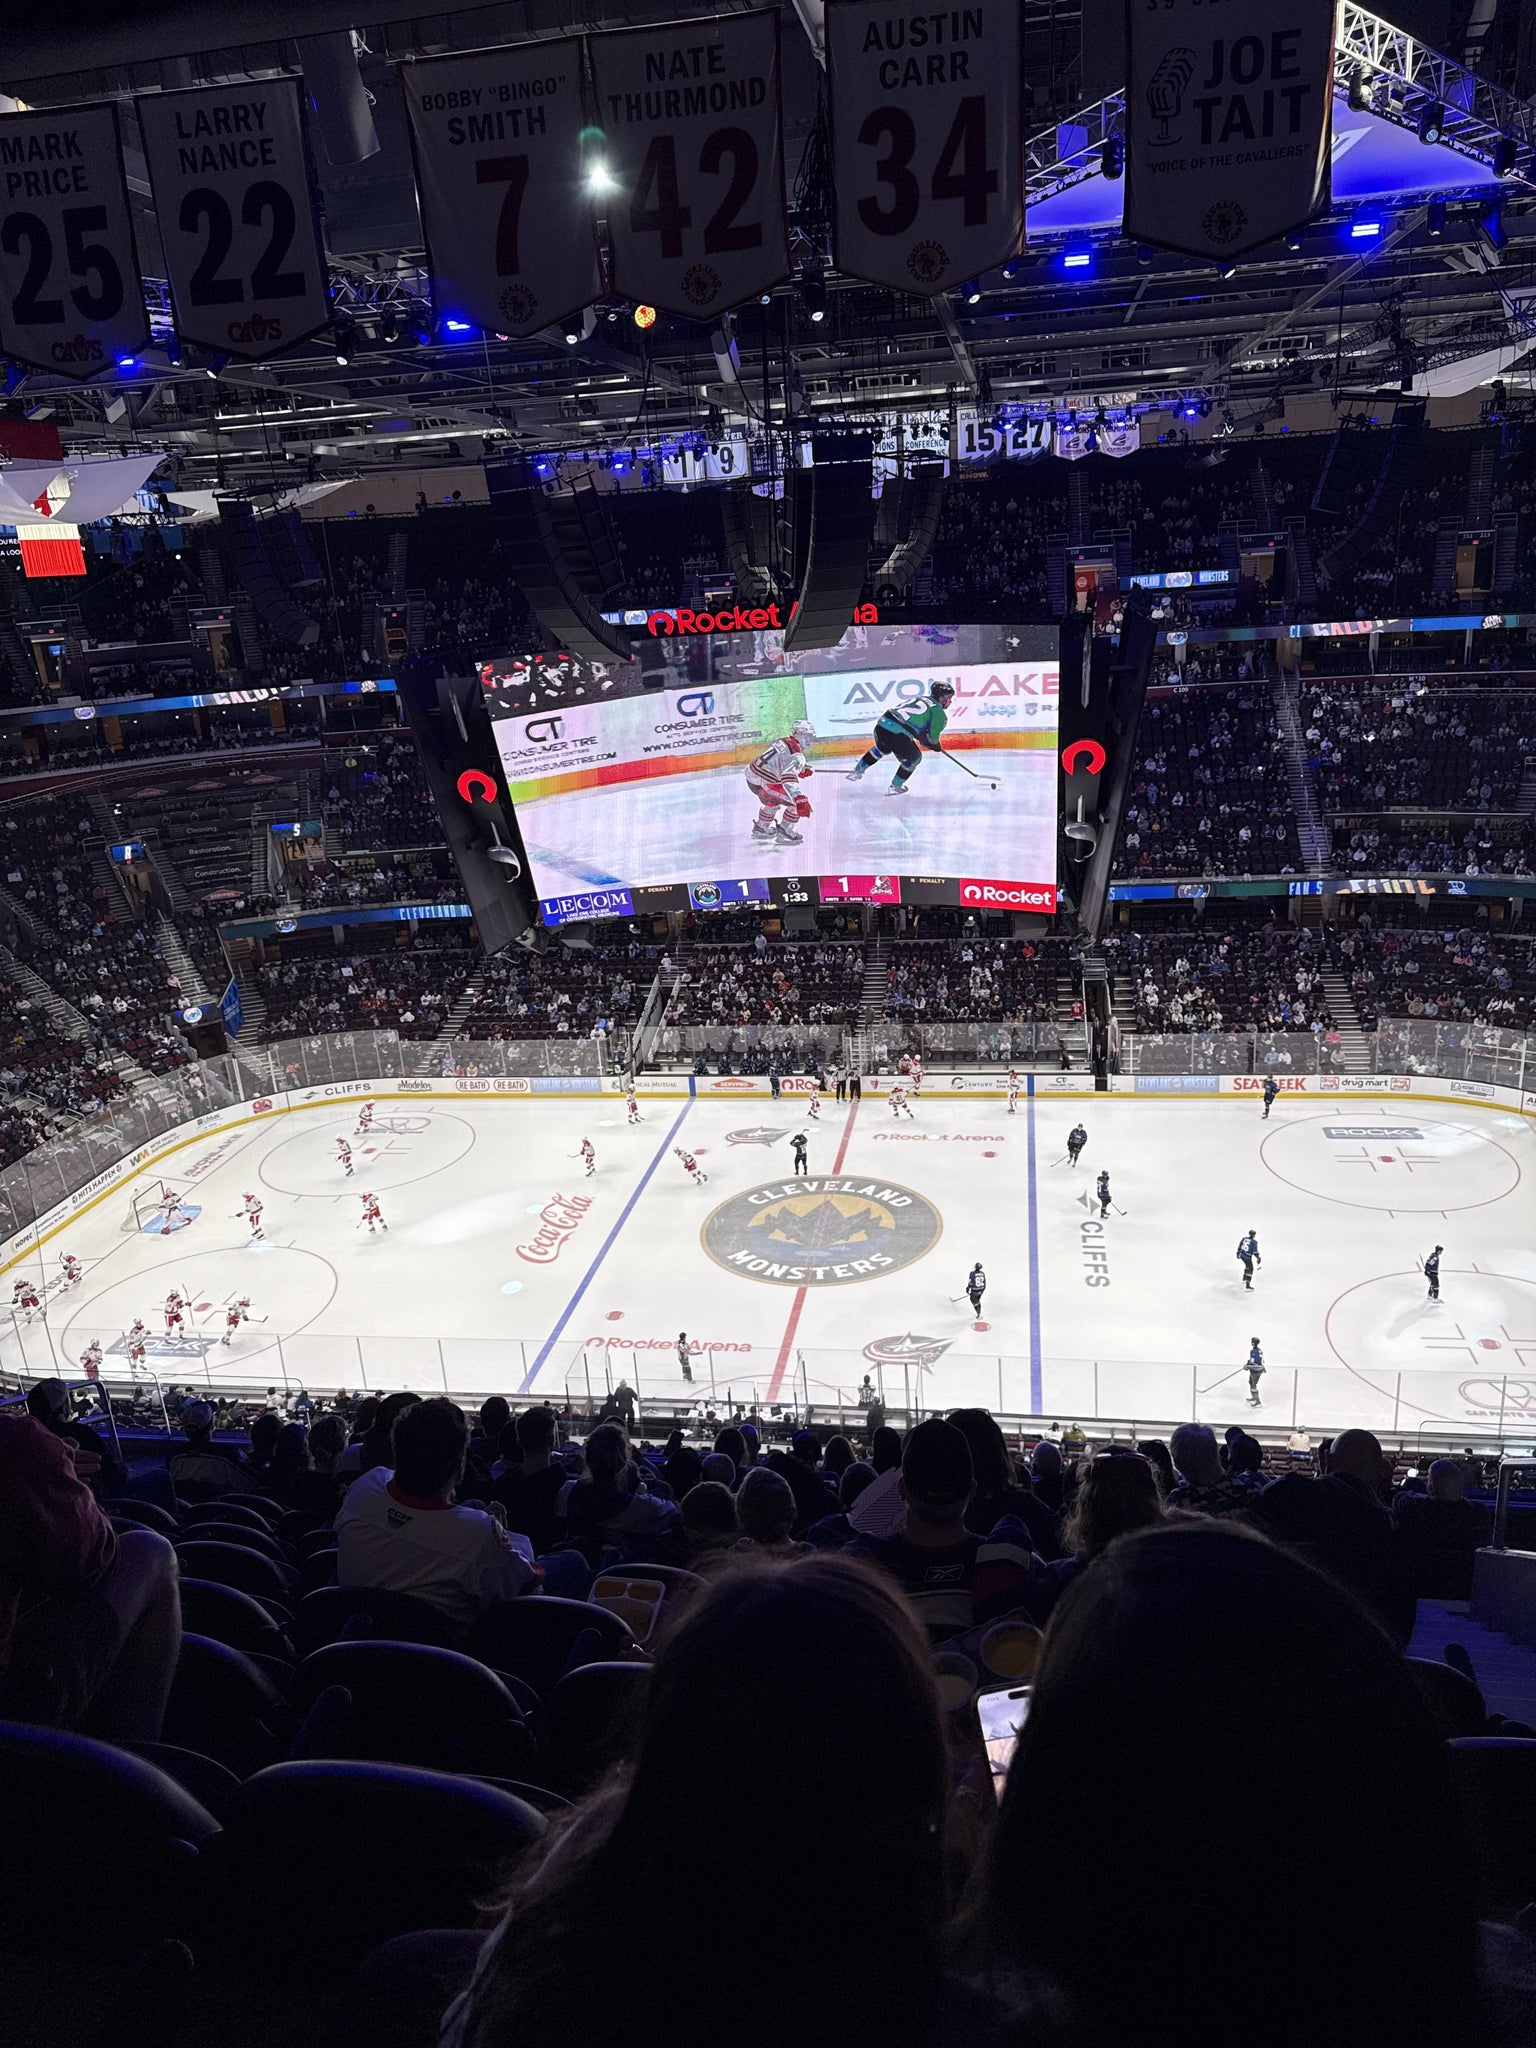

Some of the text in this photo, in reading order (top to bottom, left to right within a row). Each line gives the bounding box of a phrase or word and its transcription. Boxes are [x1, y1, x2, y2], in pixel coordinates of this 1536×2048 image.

[862, 8, 983, 53] AUSTIN
[645, 44, 726, 82] NATE
[879, 51, 970, 90] CARR
[1204, 28, 1302, 89] JOE
[422, 90, 482, 112] BOBBY
[608, 77, 767, 124] THURMOND
[1193, 84, 1311, 145] TAIT
[175, 102, 267, 139] LARRY
[447, 106, 547, 146] SMITH
[0, 130, 83, 165] MARK
[178, 138, 277, 175] NANCE
[1191, 158, 1206, 169] OF
[1210, 154, 1232, 167] THE
[857, 95, 998, 236] 34
[6, 165, 88, 198] PRICE
[630, 126, 763, 258] 42
[476, 154, 530, 277] 7
[179, 181, 306, 307] 22
[1, 205, 124, 325] 25
[905, 439, 947, 449] CONFERENCE
[965, 422, 995, 453] 15
[1012, 419, 1044, 449] 27
[720, 446, 733, 474] 9
[1130, 571, 1229, 588] CLEVELAND MONSTERS
[677, 603, 782, 634] Rocket
[677, 692, 715, 717] CT
[977, 703, 1017, 717] Jeep
[525, 716, 563, 742] CT
[654, 713, 745, 733] CONSUMER TIRE
[503, 736, 598, 760] CONSUMER TIRE
[186, 826, 218, 836] Cleaning.
[189, 845, 232, 856] Restoration.
[194, 867, 243, 878] Construction.
[838, 876, 849, 893] 1
[737, 880, 749, 897] 1
[782, 892, 808, 903] 1:33
[983, 885, 1052, 907] Rocket
[400, 905, 457, 920] CLEVELAND
[325, 1083, 371, 1095] CLIFFS
[1341, 1078, 1388, 1088] drug mart
[952, 1134, 1005, 1142] Arena
[130, 1148, 150, 1167] WM
[77, 1169, 116, 1201] HITS HAPPEN
[748, 1180, 912, 1208] CLEVELAND
[15, 1232, 33, 1249] NOPEC
[1080, 1221, 1110, 1288] CLIFFS
[728, 1250, 894, 1280] MONSTERS
[606, 1337, 752, 1352] Rocket Arena
